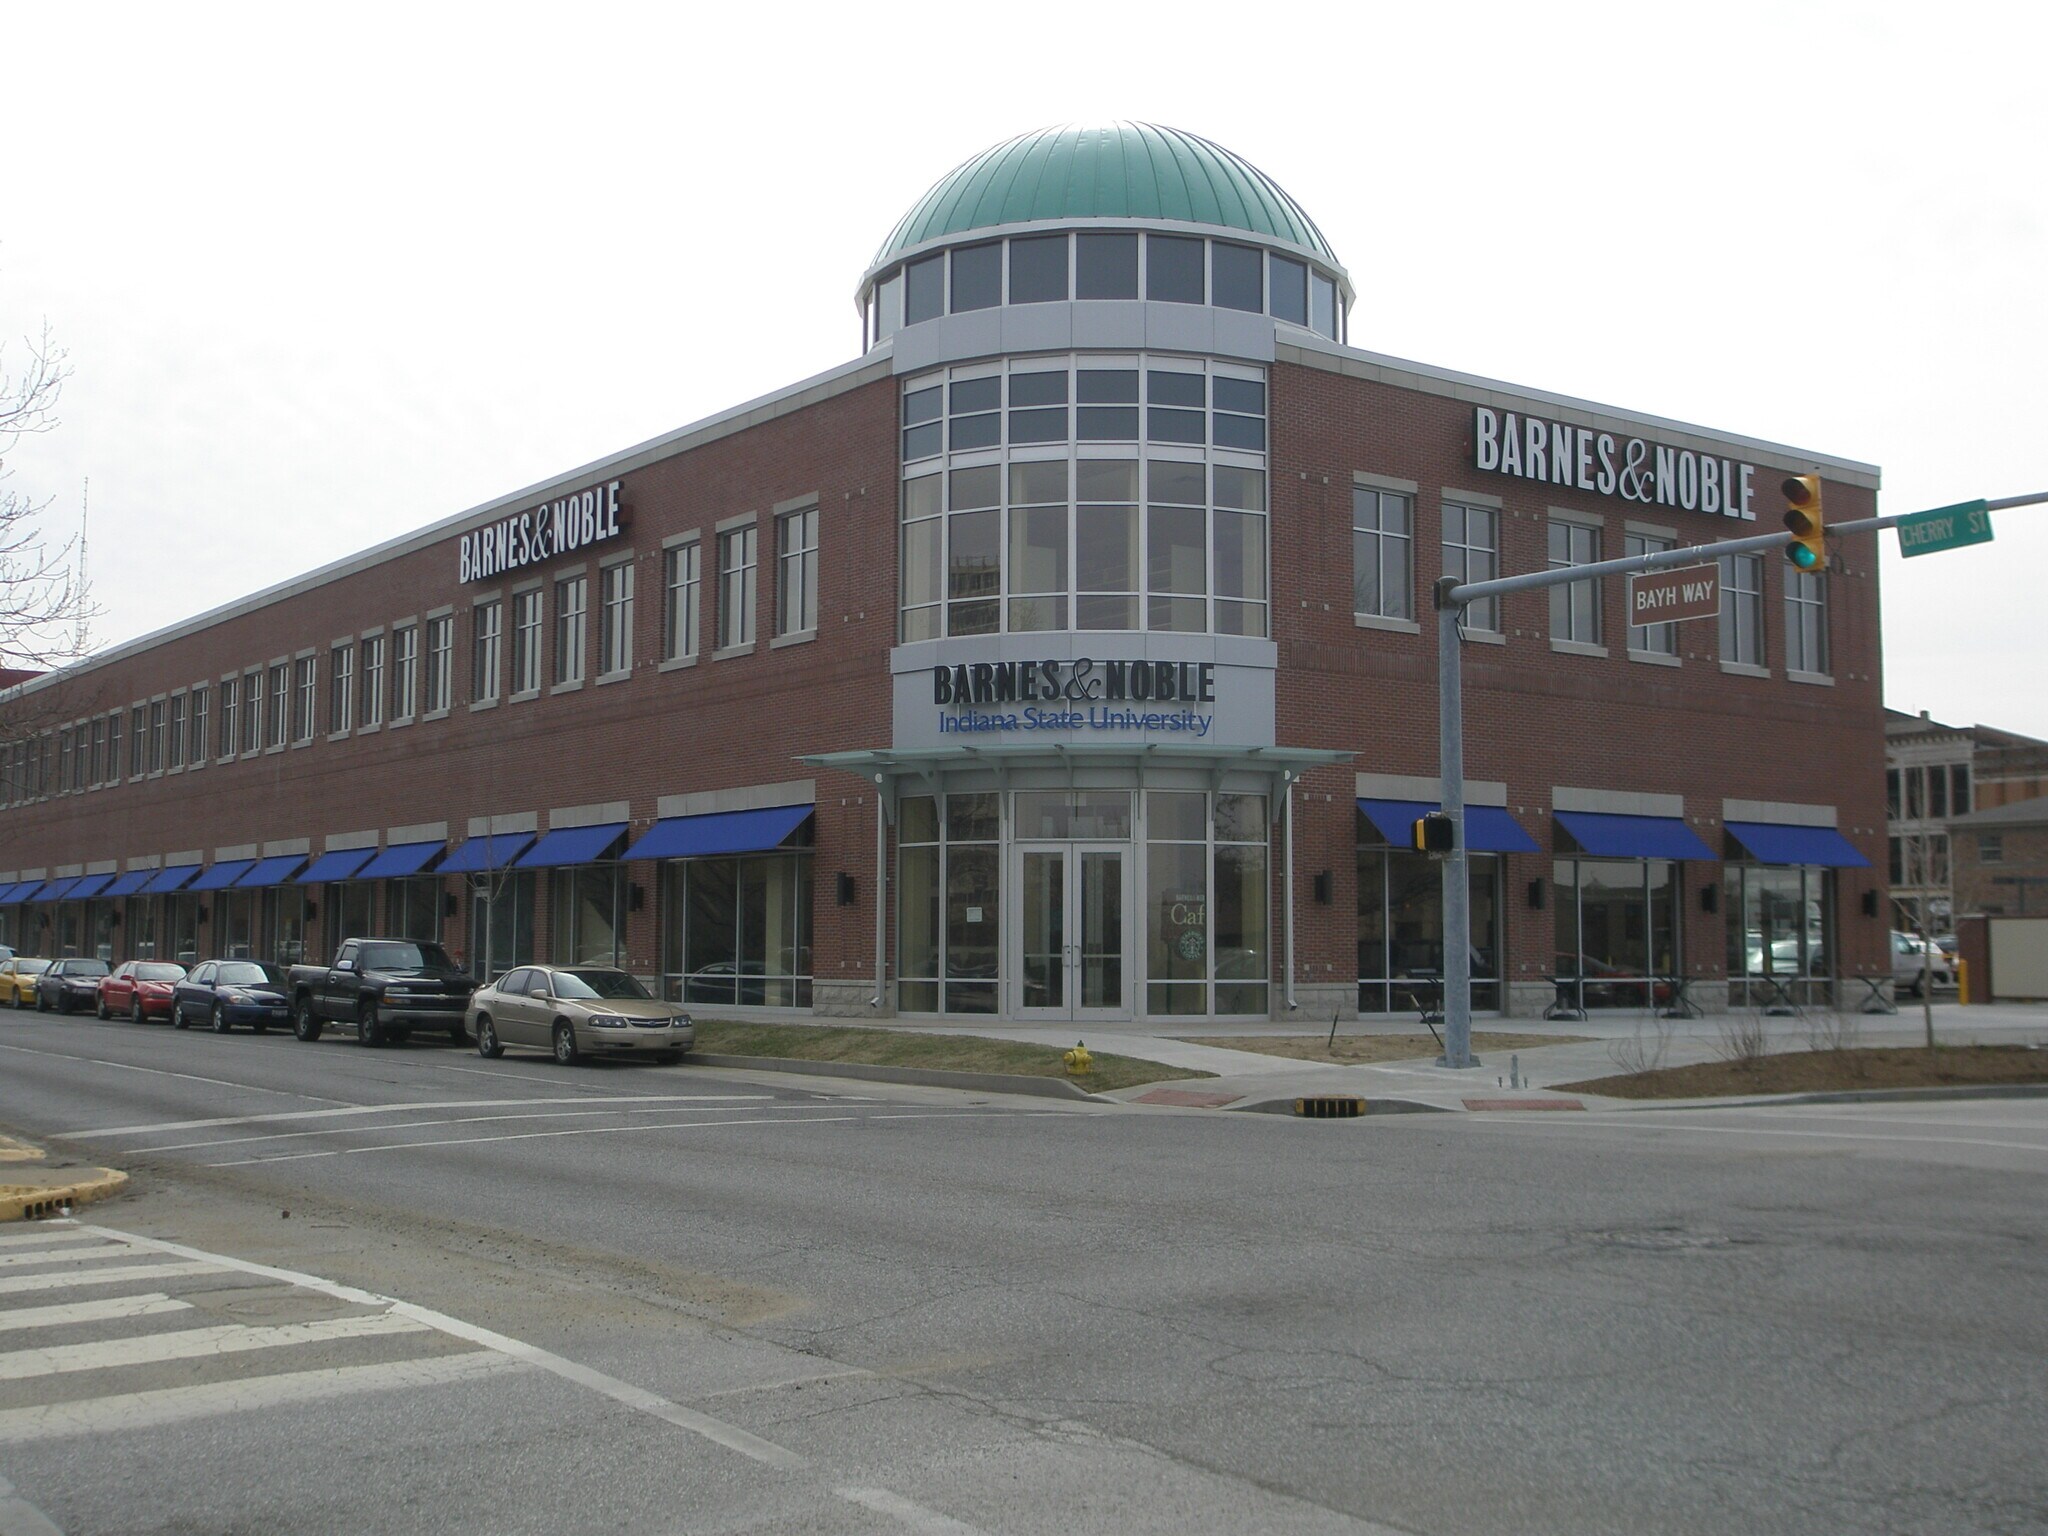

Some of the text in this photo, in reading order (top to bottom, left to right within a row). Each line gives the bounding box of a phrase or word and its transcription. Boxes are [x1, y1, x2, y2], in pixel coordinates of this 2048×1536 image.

[1655, 445, 1757, 521] NOBLE
[1901, 510, 1987, 547] CHERRY ST
[1637, 580, 1714, 611] BAYH WAY
[1105, 659, 1216, 703] NOBLE
[939, 706, 1213, 737] Indiana State University
[1171, 903, 1206, 925] Caf
